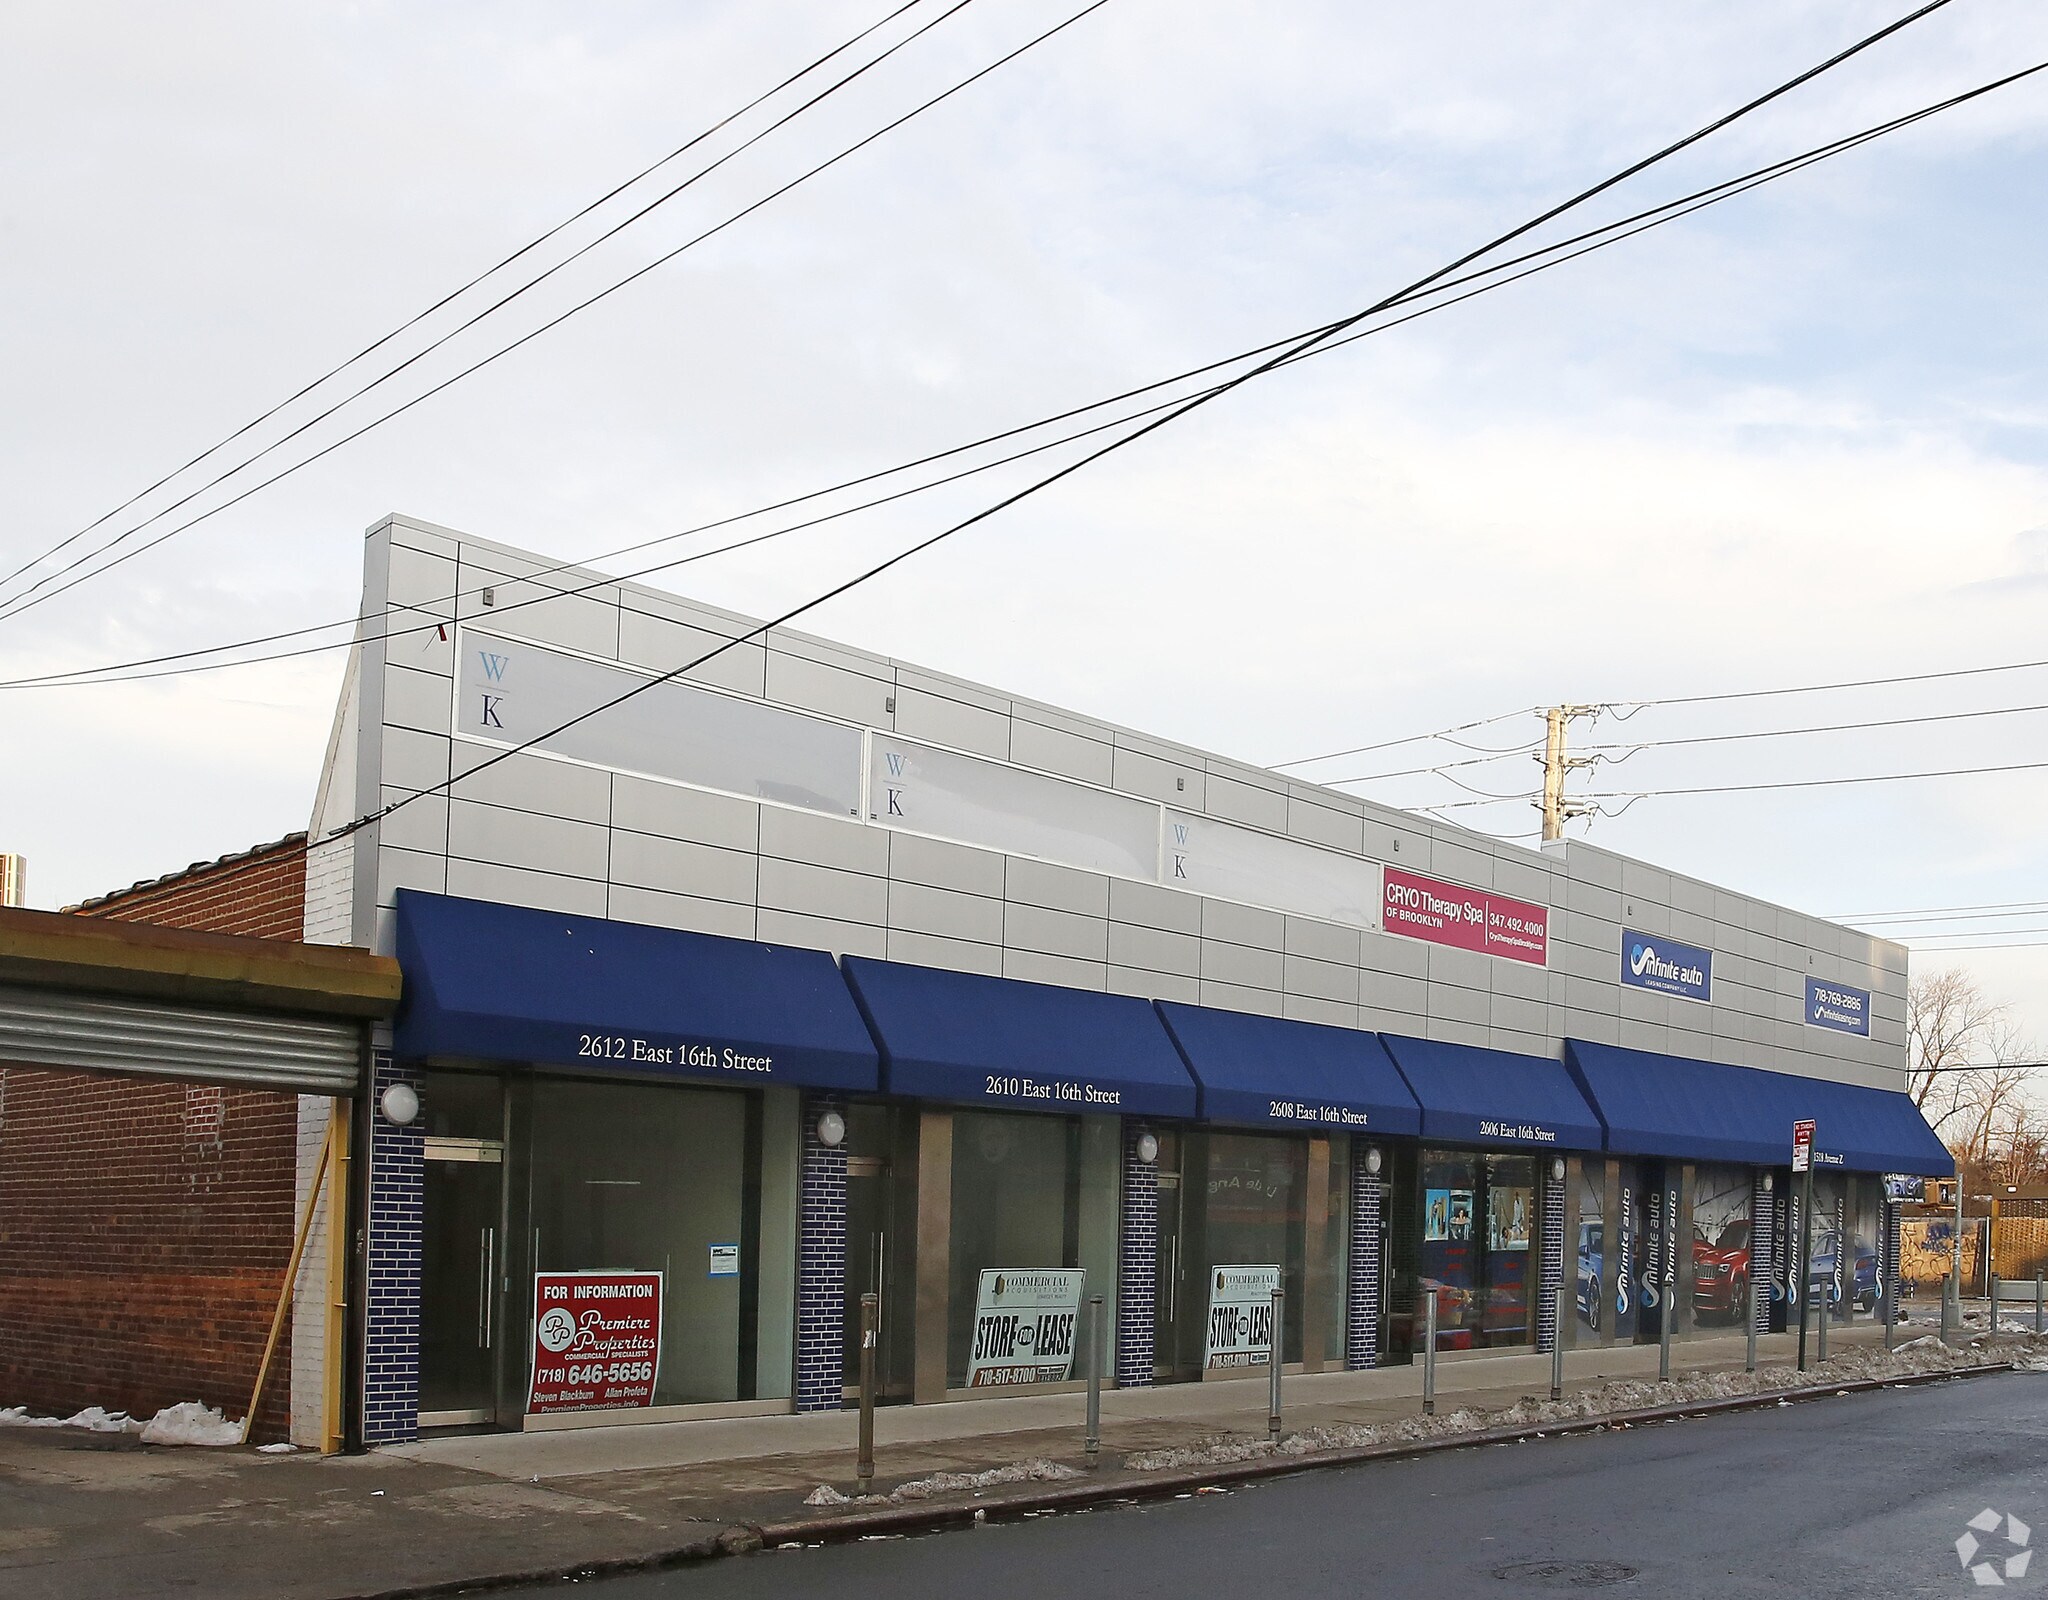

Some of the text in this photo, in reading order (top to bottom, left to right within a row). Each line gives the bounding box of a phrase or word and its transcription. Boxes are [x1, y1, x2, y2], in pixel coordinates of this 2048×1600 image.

[478, 651, 510, 683] W
[481, 694, 504, 729] K
[885, 752, 907, 778] W
[887, 788, 904, 817] K
[1174, 824, 1189, 846] W
[1174, 854, 1187, 879] K
[1386, 883, 1484, 926] CRYO Therapy Spa
[1386, 906, 1443, 929] OF BROOKLYN
[1489, 912, 1544, 937] 347.492.4000
[1680, 965, 1703, 986] auto
[578, 1034, 772, 1072] 2612 East 16th Street
[985, 1075, 1121, 1104] 2610 East 16th Street
[1269, 1101, 1368, 1125] 2608 East 16th Street
[1480, 1121, 1555, 1141] 2606 East 16th Street
[1622, 1187, 1631, 1228] auto
[1648, 1193, 1660, 1229] auto
[1669, 1190, 1677, 1229] auto
[1774, 1198, 1786, 1231] auto
[544, 1284, 653, 1299] FOR INFORMATION
[1006, 1276, 1069, 1287] COMMERCIAL
[1226, 1274, 1276, 1284] COMMERCIAL
[579, 1309, 651, 1331] Premiere
[1210, 1306, 1239, 1348] STORE
[1248, 1306, 1271, 1346] LEAS
[572, 1330, 656, 1358] Properties
[975, 1313, 1074, 1360] STORE FOR LEASE
[564, 1350, 649, 1361] COMMERCIAL SPECIALISTS
[537, 1361, 652, 1385] (718) 646-5656
[978, 1367, 1036, 1385] 718-517-8700
[533, 1385, 648, 1403] Steven Blackburn Allan Profeta
